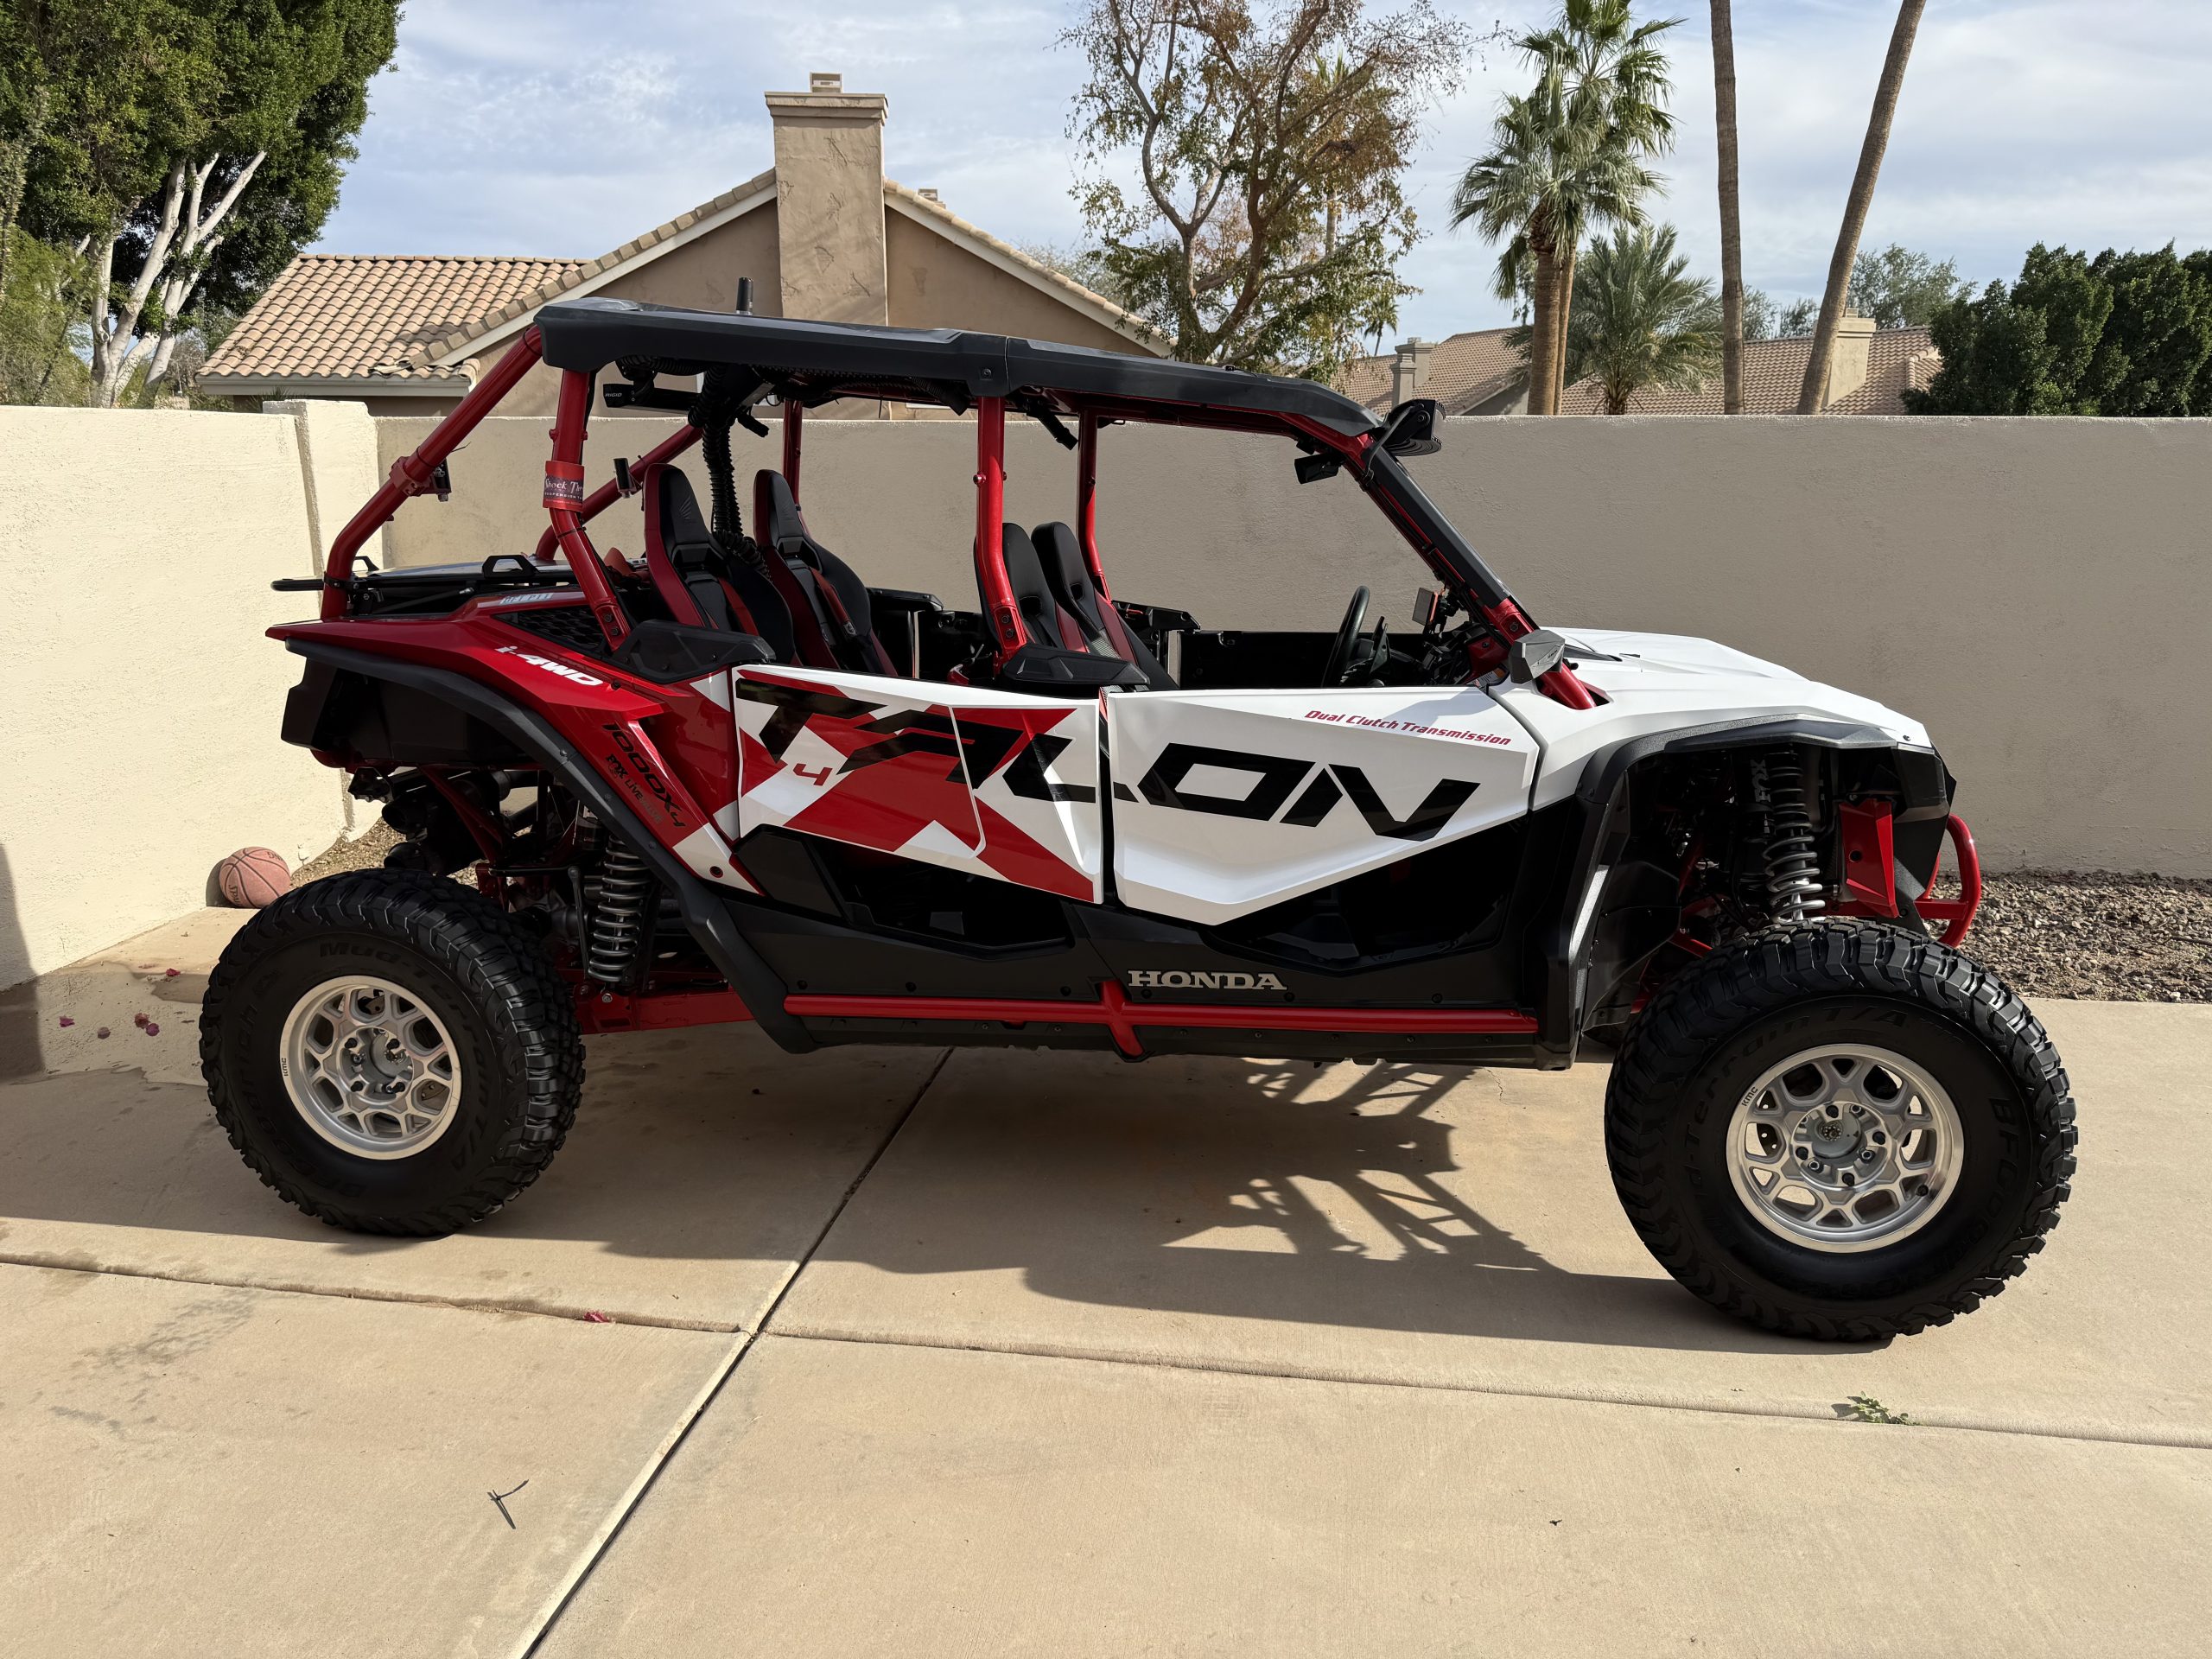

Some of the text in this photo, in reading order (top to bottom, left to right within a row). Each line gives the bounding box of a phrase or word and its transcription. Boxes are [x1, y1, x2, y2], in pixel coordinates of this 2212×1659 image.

[1304, 709, 1512, 746] Dual Clutch Transmission
[735, 677, 1481, 842] TALON
[792, 762, 833, 786] 4
[1750, 759, 1771, 803] FOX
[1127, 969, 1287, 990] HONDA
[1741, 1086, 1758, 1107] KMC
